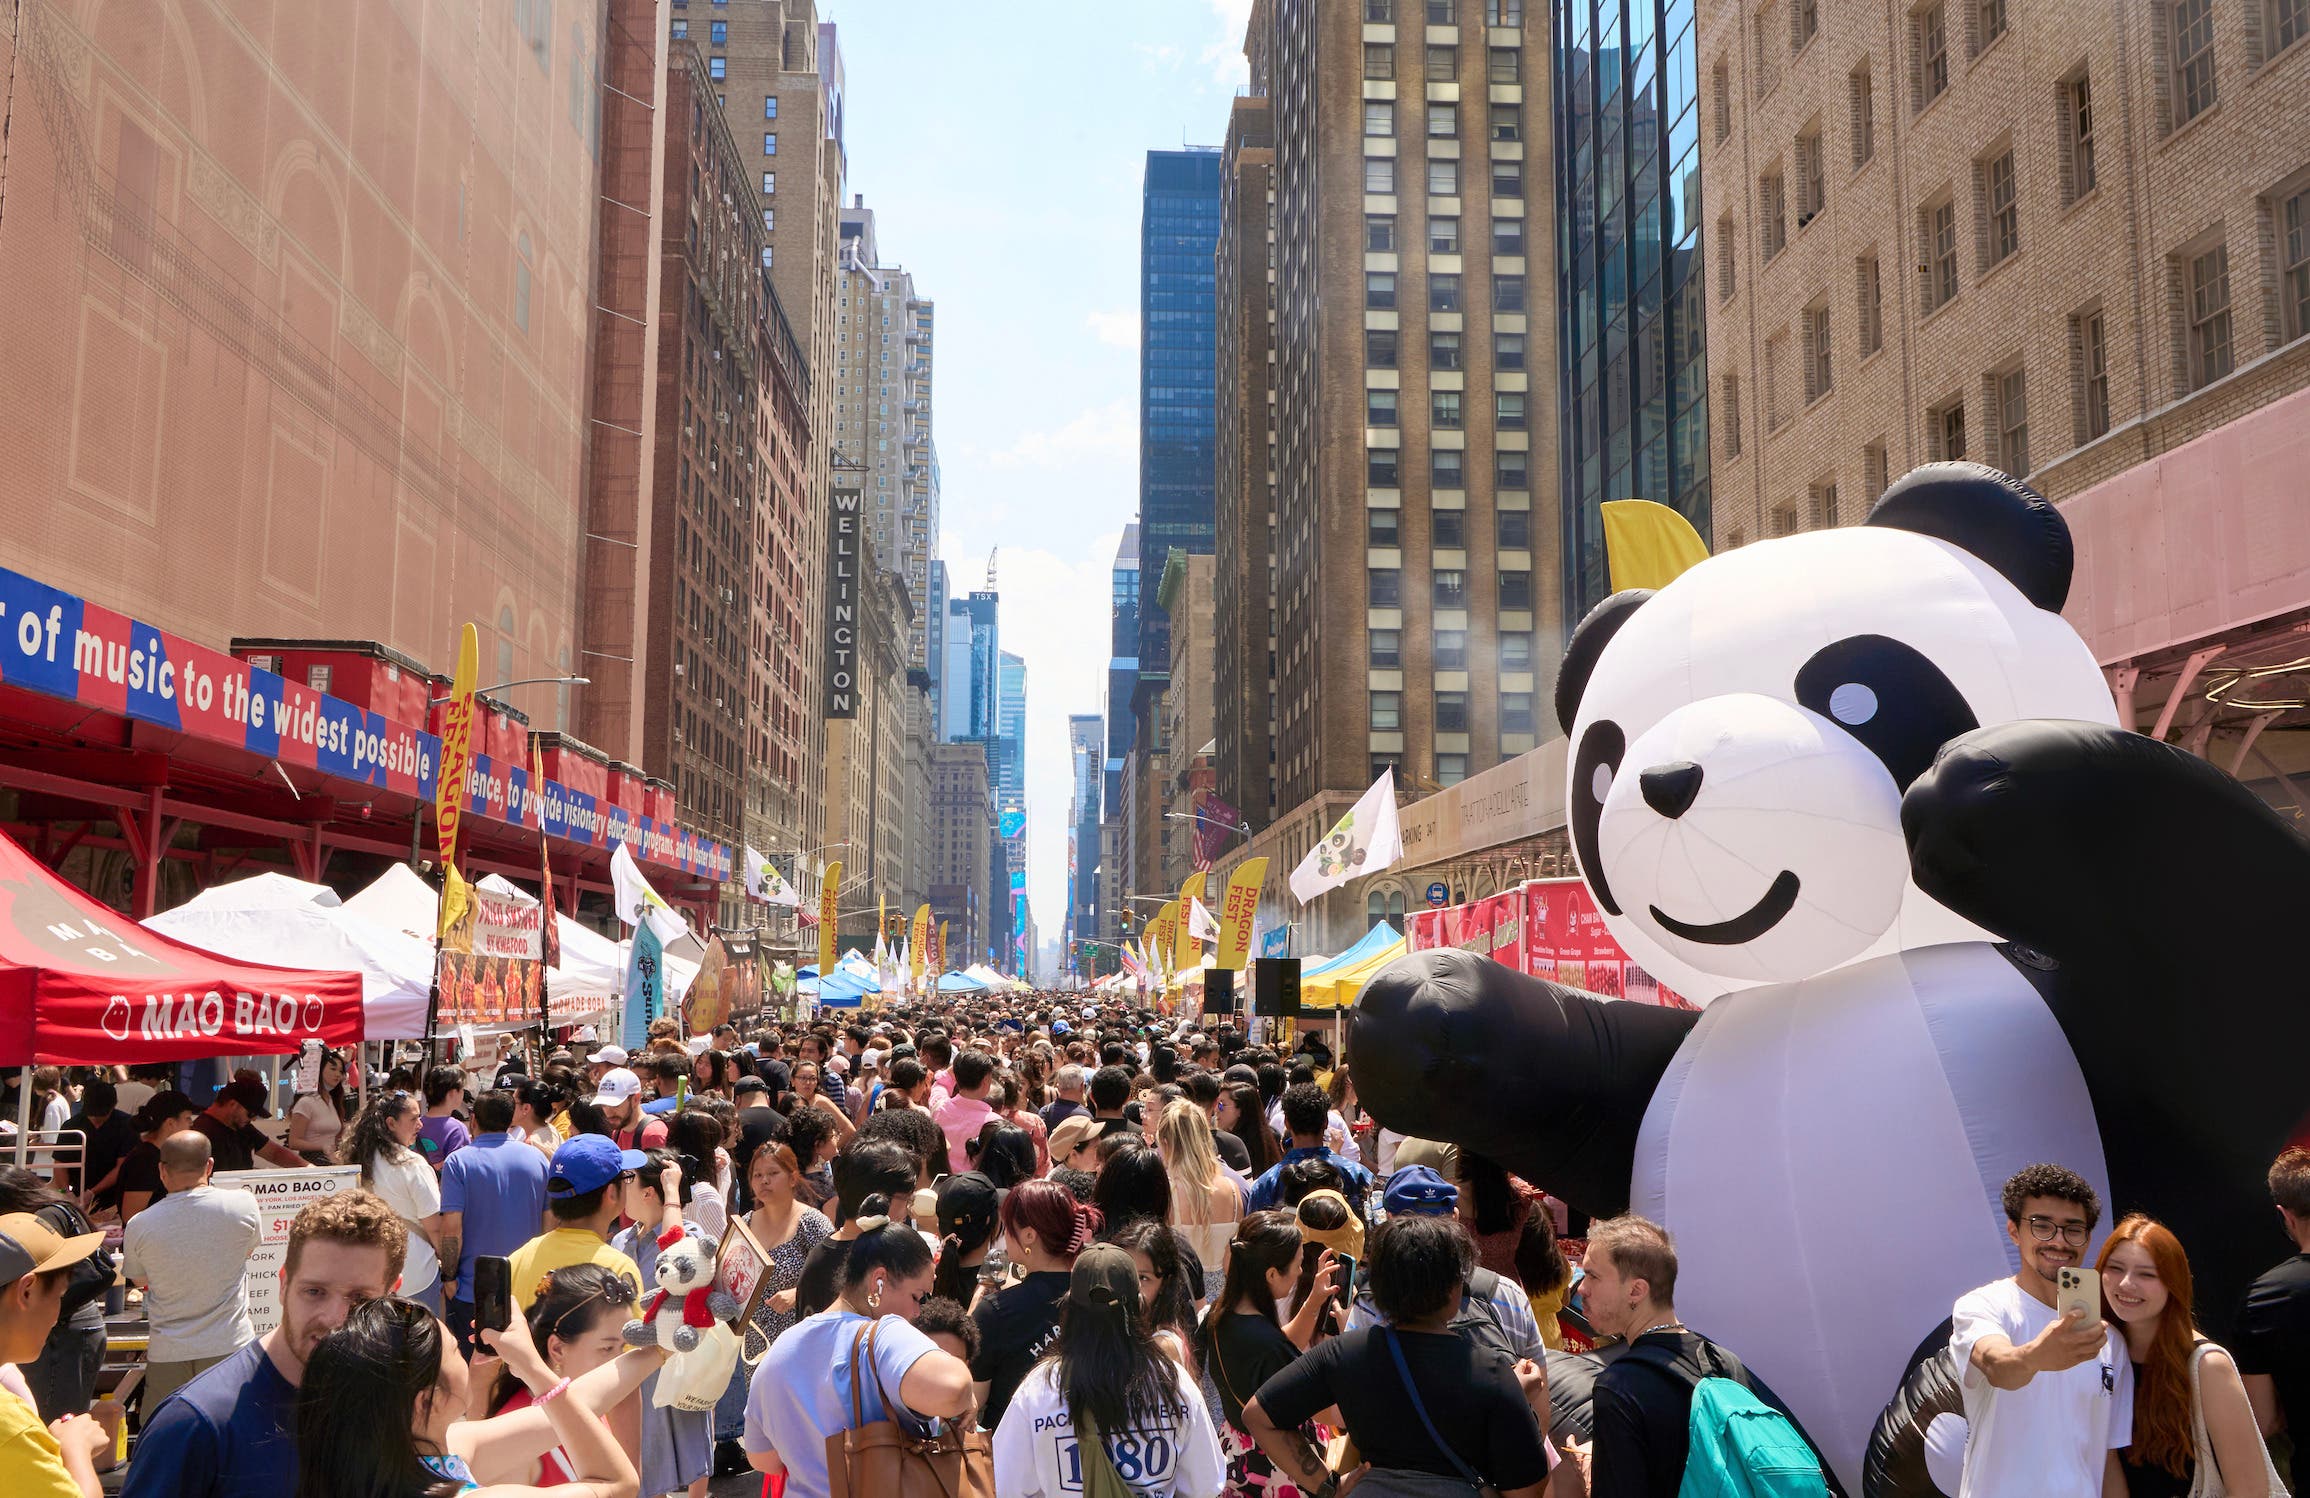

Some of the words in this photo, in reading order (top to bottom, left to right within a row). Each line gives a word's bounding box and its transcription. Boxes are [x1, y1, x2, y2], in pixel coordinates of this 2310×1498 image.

[833, 495, 858, 711] WELLINGTON
[18, 604, 62, 662] of
[73, 629, 174, 699] music
[183, 660, 213, 712] to
[223, 673, 265, 729] the
[273, 693, 348, 756] widest
[353, 728, 430, 781] possible
[463, 758, 504, 812] ience,
[507, 776, 520, 809] to
[564, 795, 607, 841] visionary
[607, 812, 643, 848] education
[643, 829, 675, 861] programs,
[676, 838, 687, 860] and
[687, 841, 696, 862] to
[437, 700, 460, 794] FEST
[439, 691, 472, 863] DRAGON
[1400, 824, 1422, 845] ARKING
[823, 888, 832, 926] FEST
[1180, 897, 1192, 928] FEST
[1226, 885, 1243, 923] FEST
[1235, 887, 1258, 953] DRAGON
[917, 923, 926, 964] DRAGON
[1158, 919, 1167, 944] FEST
[140, 990, 225, 1041] MAO
[234, 993, 298, 1036] BAO
[255, 1183, 288, 1194] MAO
[293, 1181, 322, 1192] BAO
[248, 1270, 278, 1280] HICK
[249, 1289, 270, 1298] EEF
[248, 1306, 270, 1315] AMB
[1064, 1436, 1170, 1484] 180
